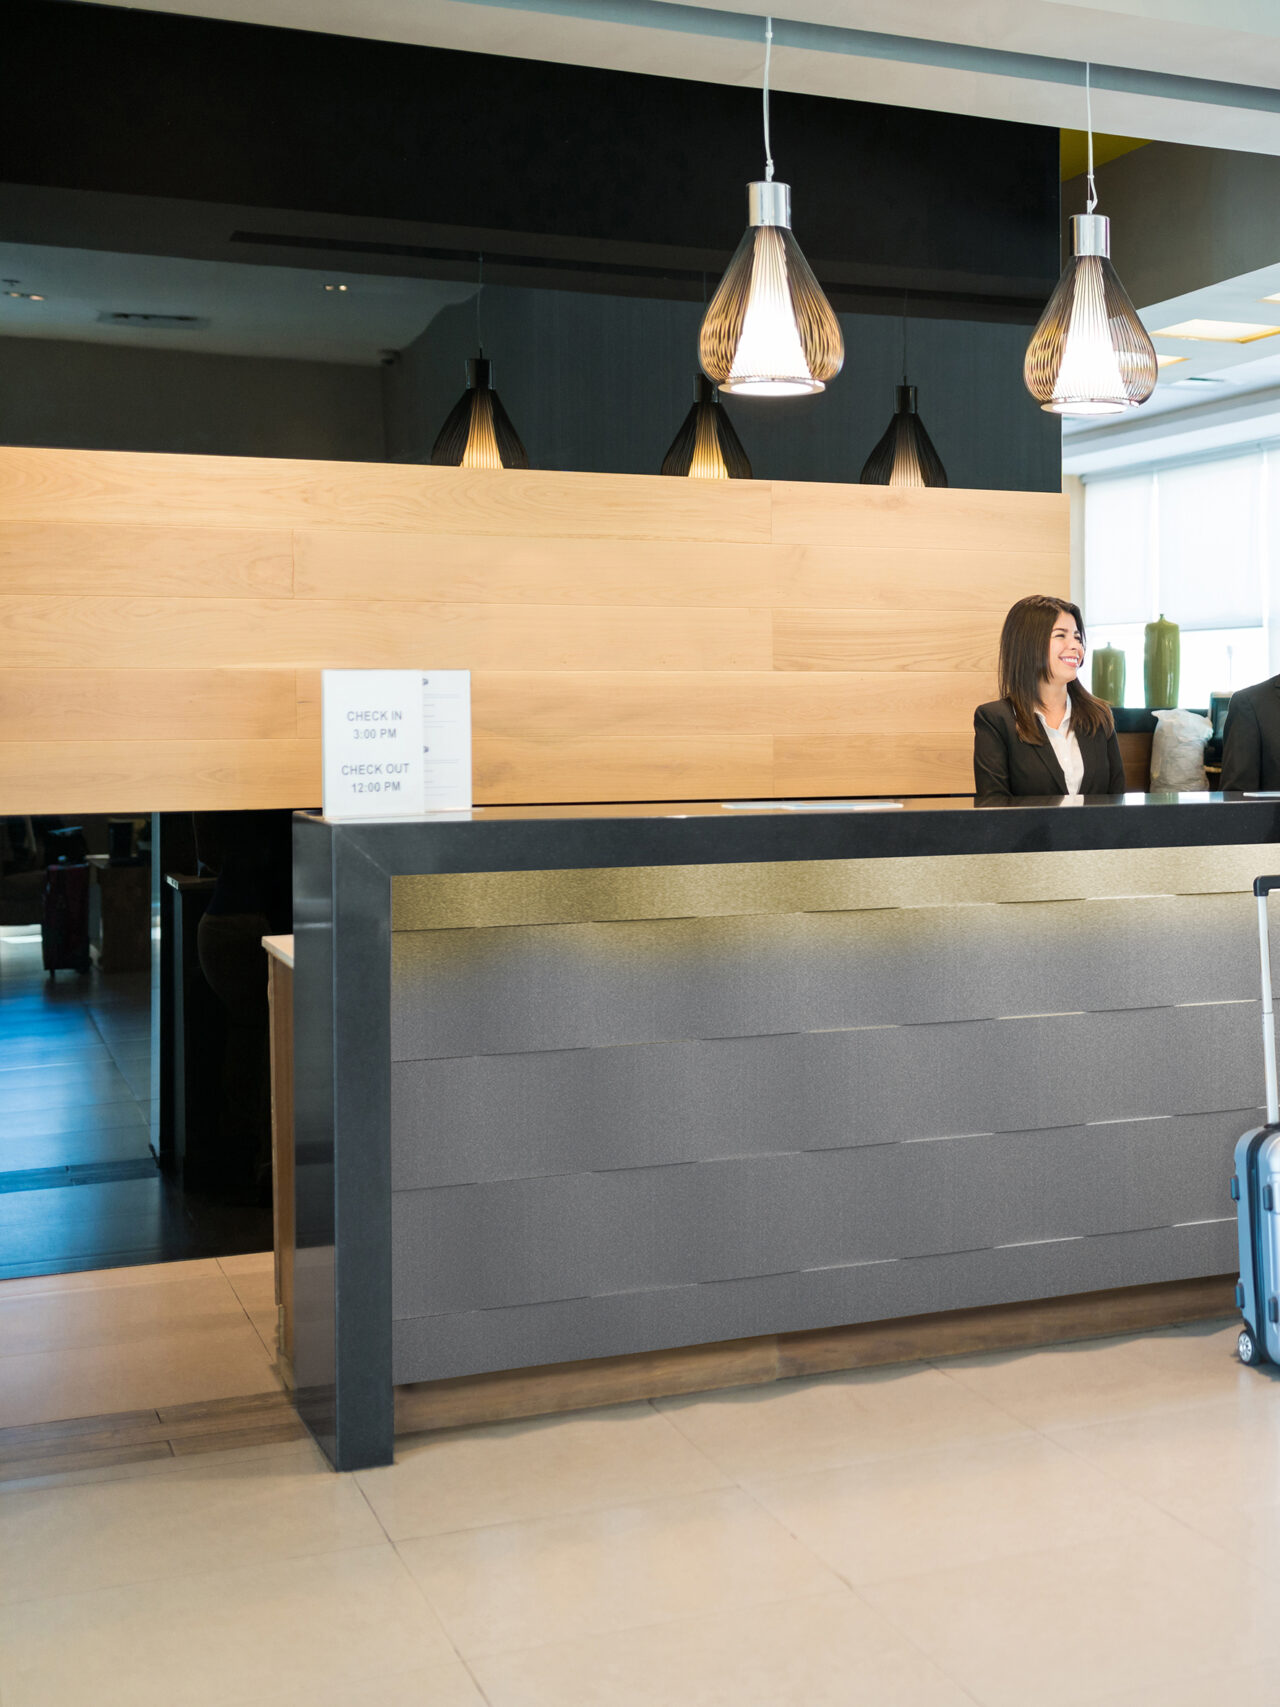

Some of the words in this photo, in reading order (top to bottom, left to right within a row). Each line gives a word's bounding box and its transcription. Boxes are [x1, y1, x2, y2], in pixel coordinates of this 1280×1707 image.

[347, 710, 388, 722] CHECK
[391, 710, 402, 721] IN
[353, 728, 376, 739] 3:00
[380, 728, 397, 738] PM
[341, 764, 383, 776] CHECK
[386, 763, 410, 774] OUT
[351, 782, 380, 793] 12:00
[384, 781, 401, 792] PM
